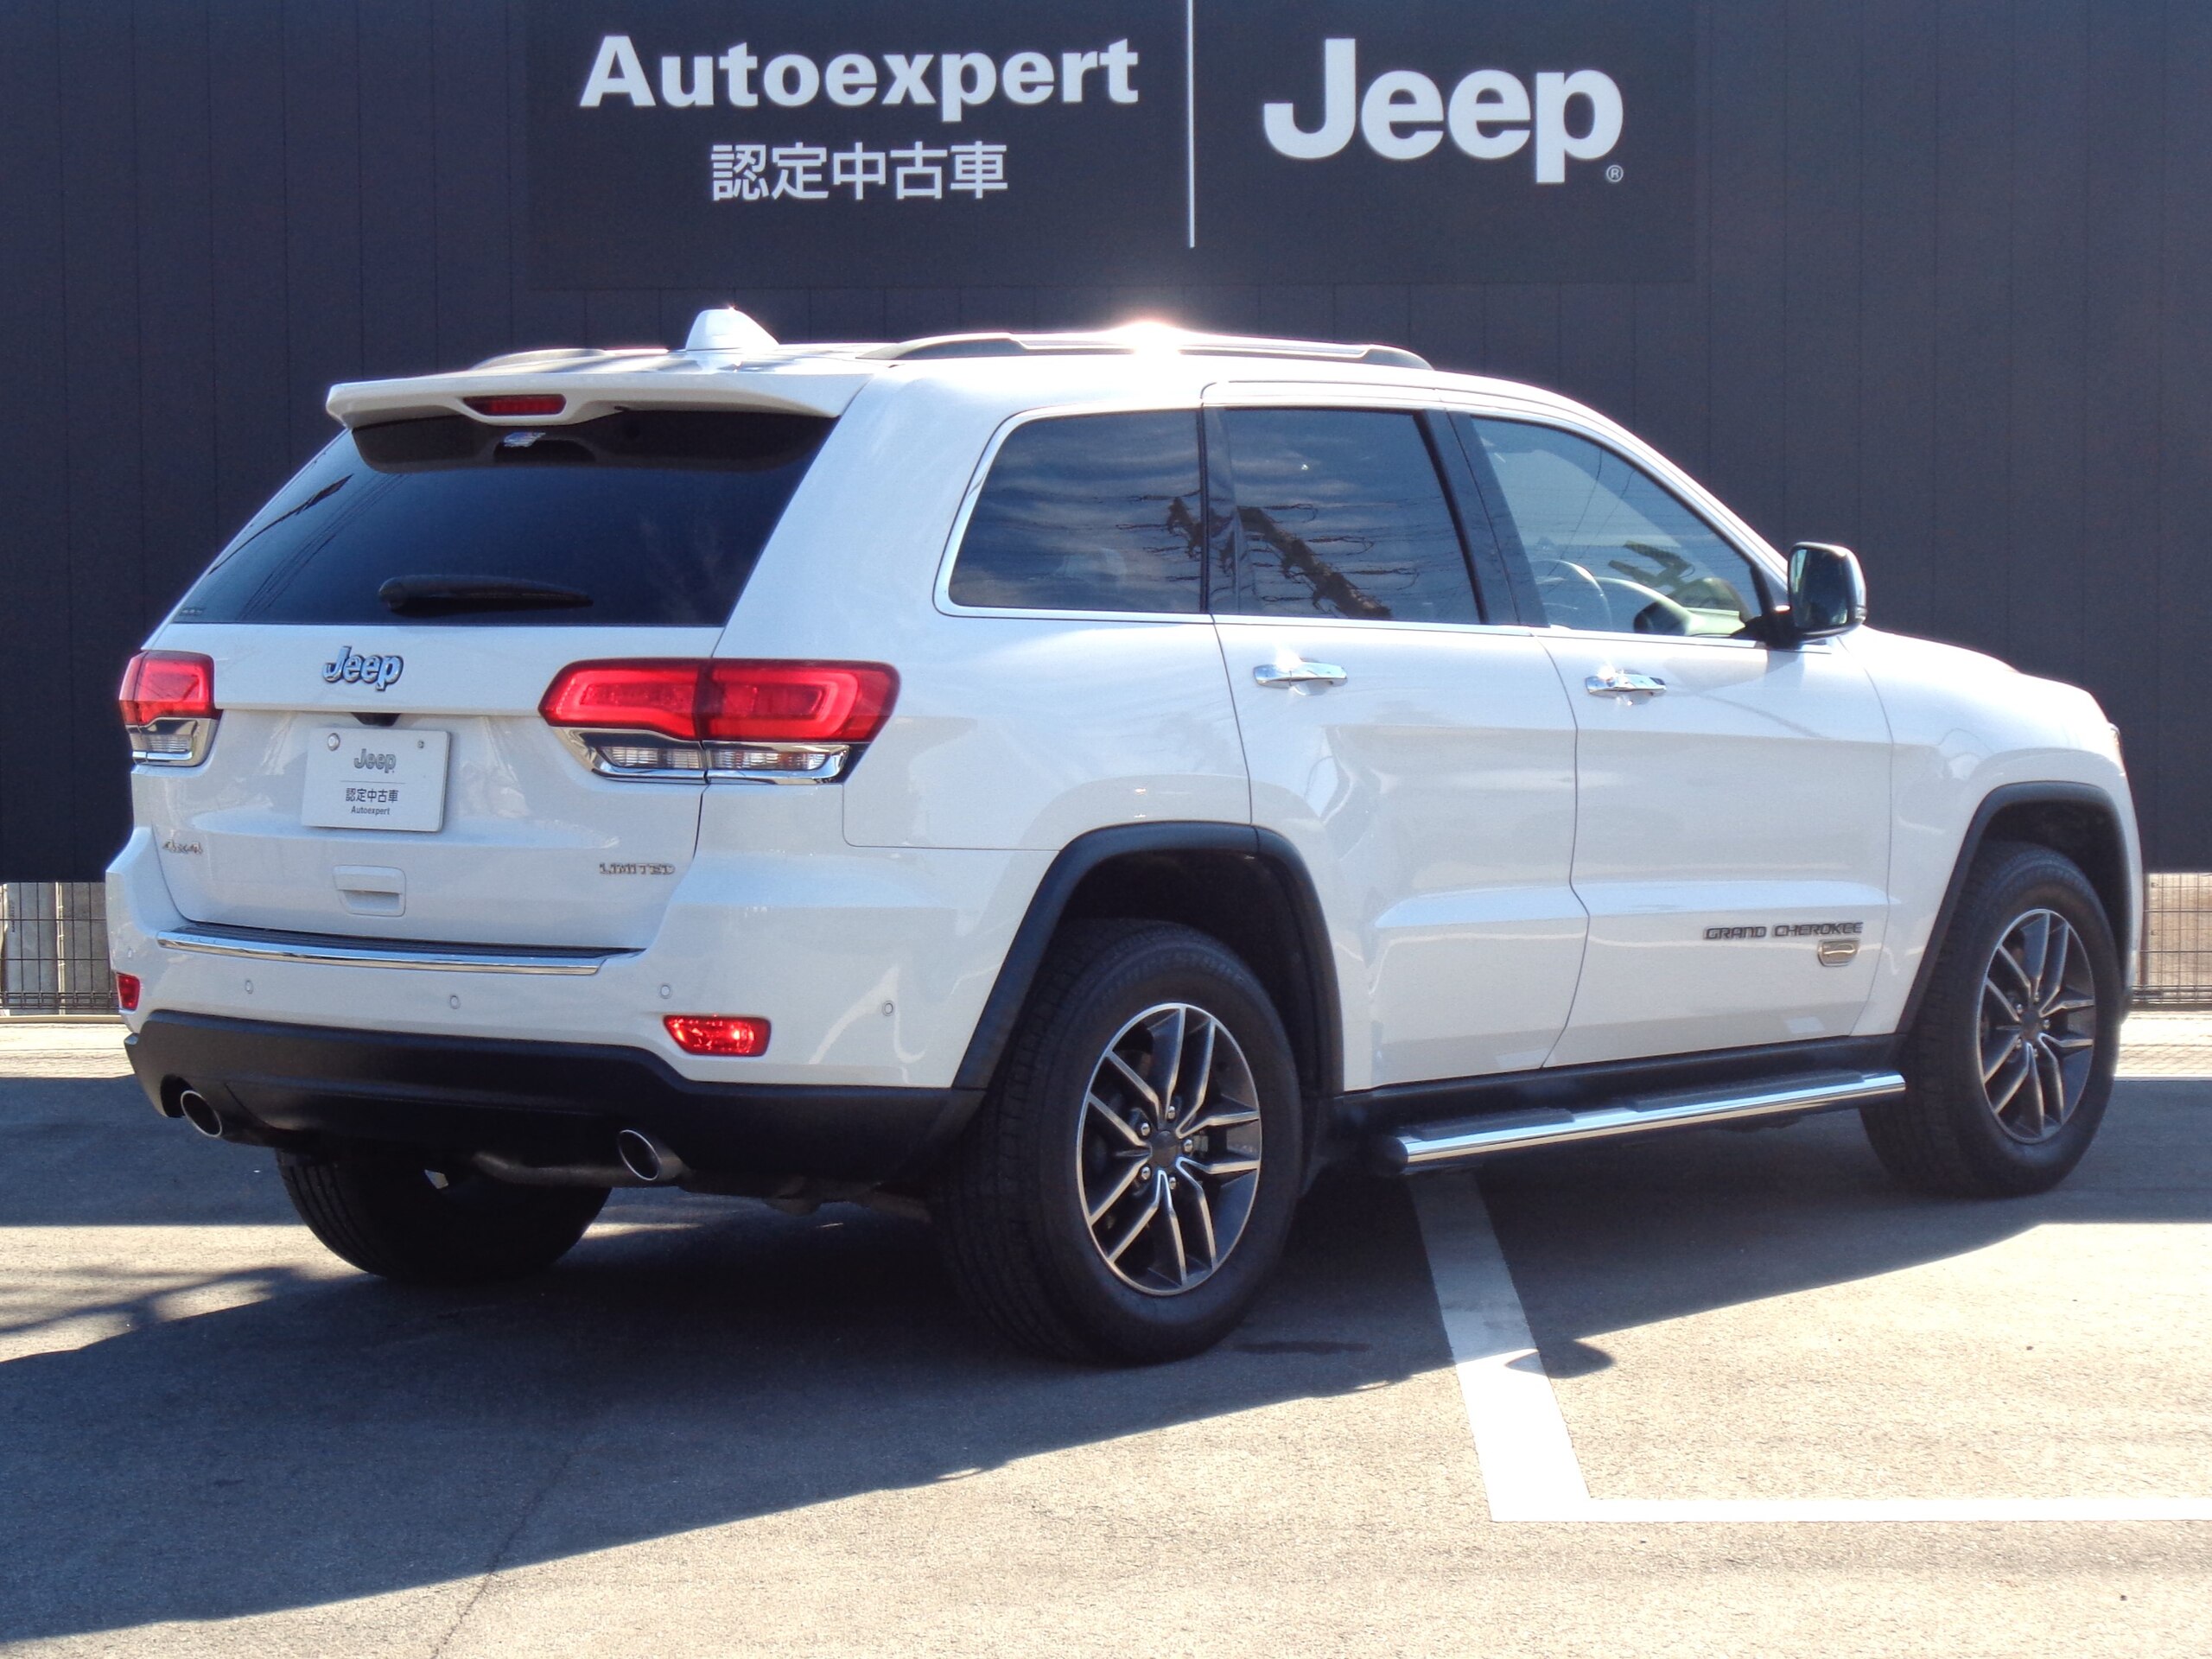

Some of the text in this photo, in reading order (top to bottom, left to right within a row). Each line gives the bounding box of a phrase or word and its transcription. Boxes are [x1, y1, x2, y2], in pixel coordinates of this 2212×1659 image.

[579, 35, 1139, 123] Autoexpert
[1263, 38, 1624, 184] Jeep
[711, 142, 1008, 201] 認定中古車
[322, 645, 404, 691] Jeep
[353, 748, 397, 773] Jeep
[346, 787, 398, 804] 認定中古車
[351, 805, 391, 817] Autoexpert
[599, 862, 676, 875] LIMITED
[1704, 922, 1863, 940] GRAND CHEROKEE
